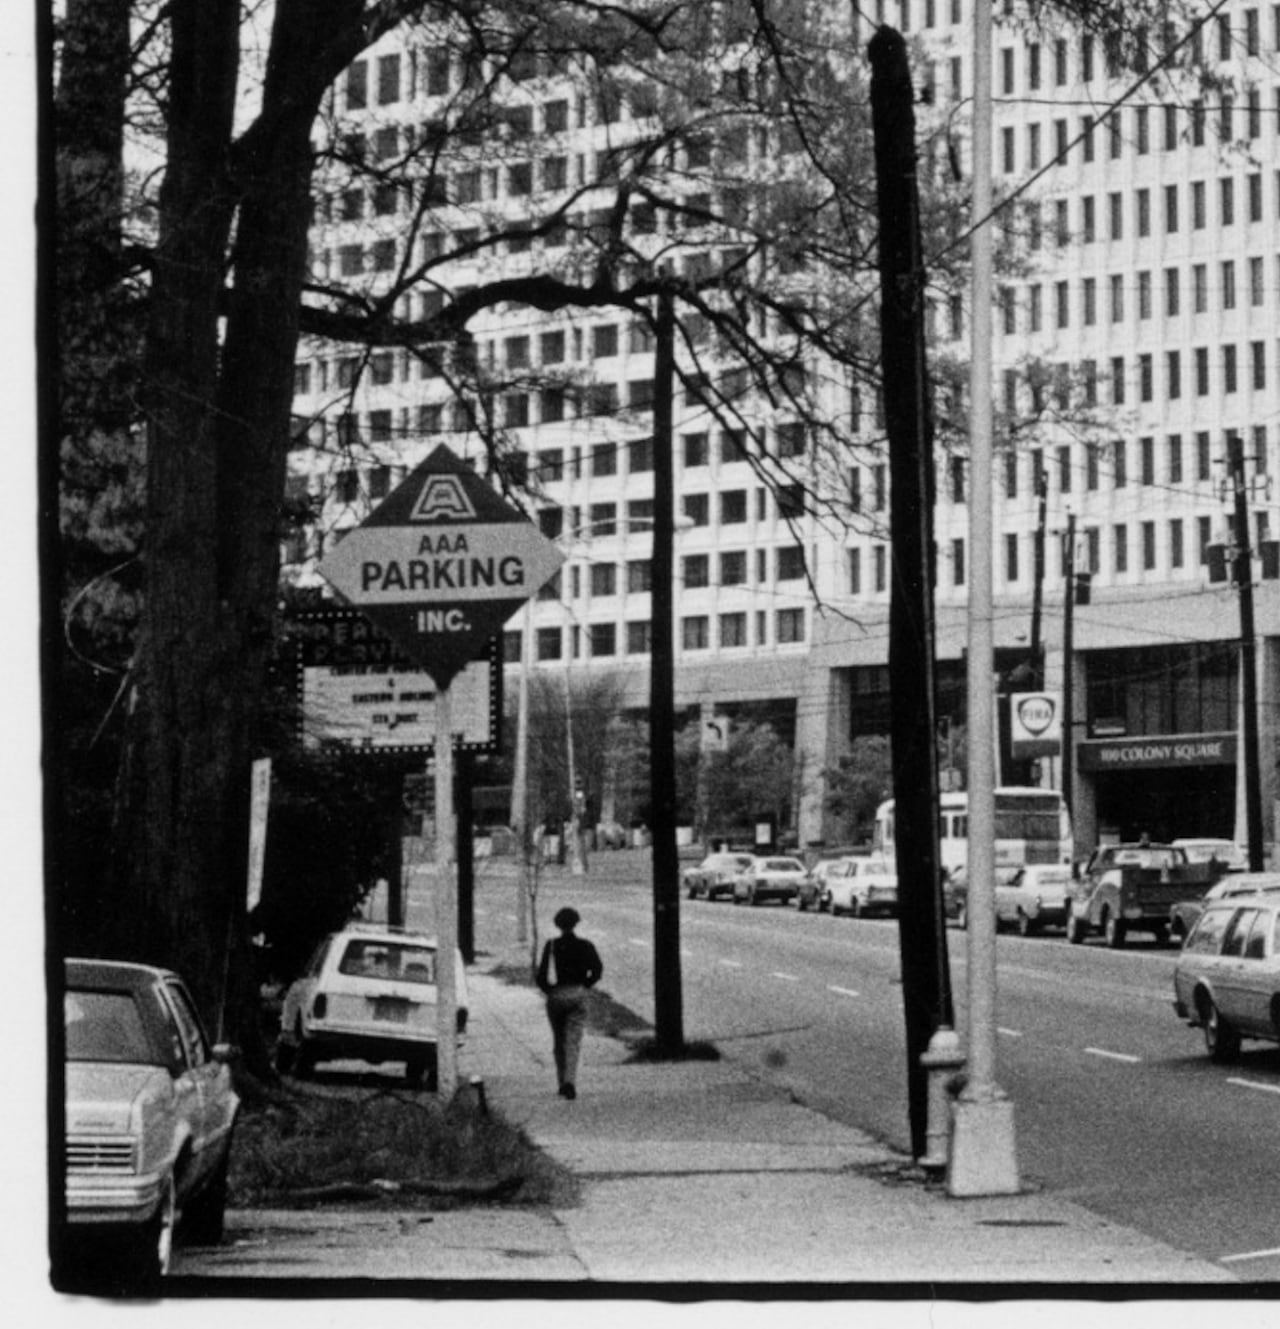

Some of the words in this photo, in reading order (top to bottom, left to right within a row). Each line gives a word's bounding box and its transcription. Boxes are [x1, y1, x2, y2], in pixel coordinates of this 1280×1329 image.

[418, 533, 469, 555] AAA
[361, 556, 525, 591] PARKING
[417, 608, 472, 633] INC.
[1120, 745, 1172, 762] COLONY
[1174, 742, 1222, 761] SQUARE
